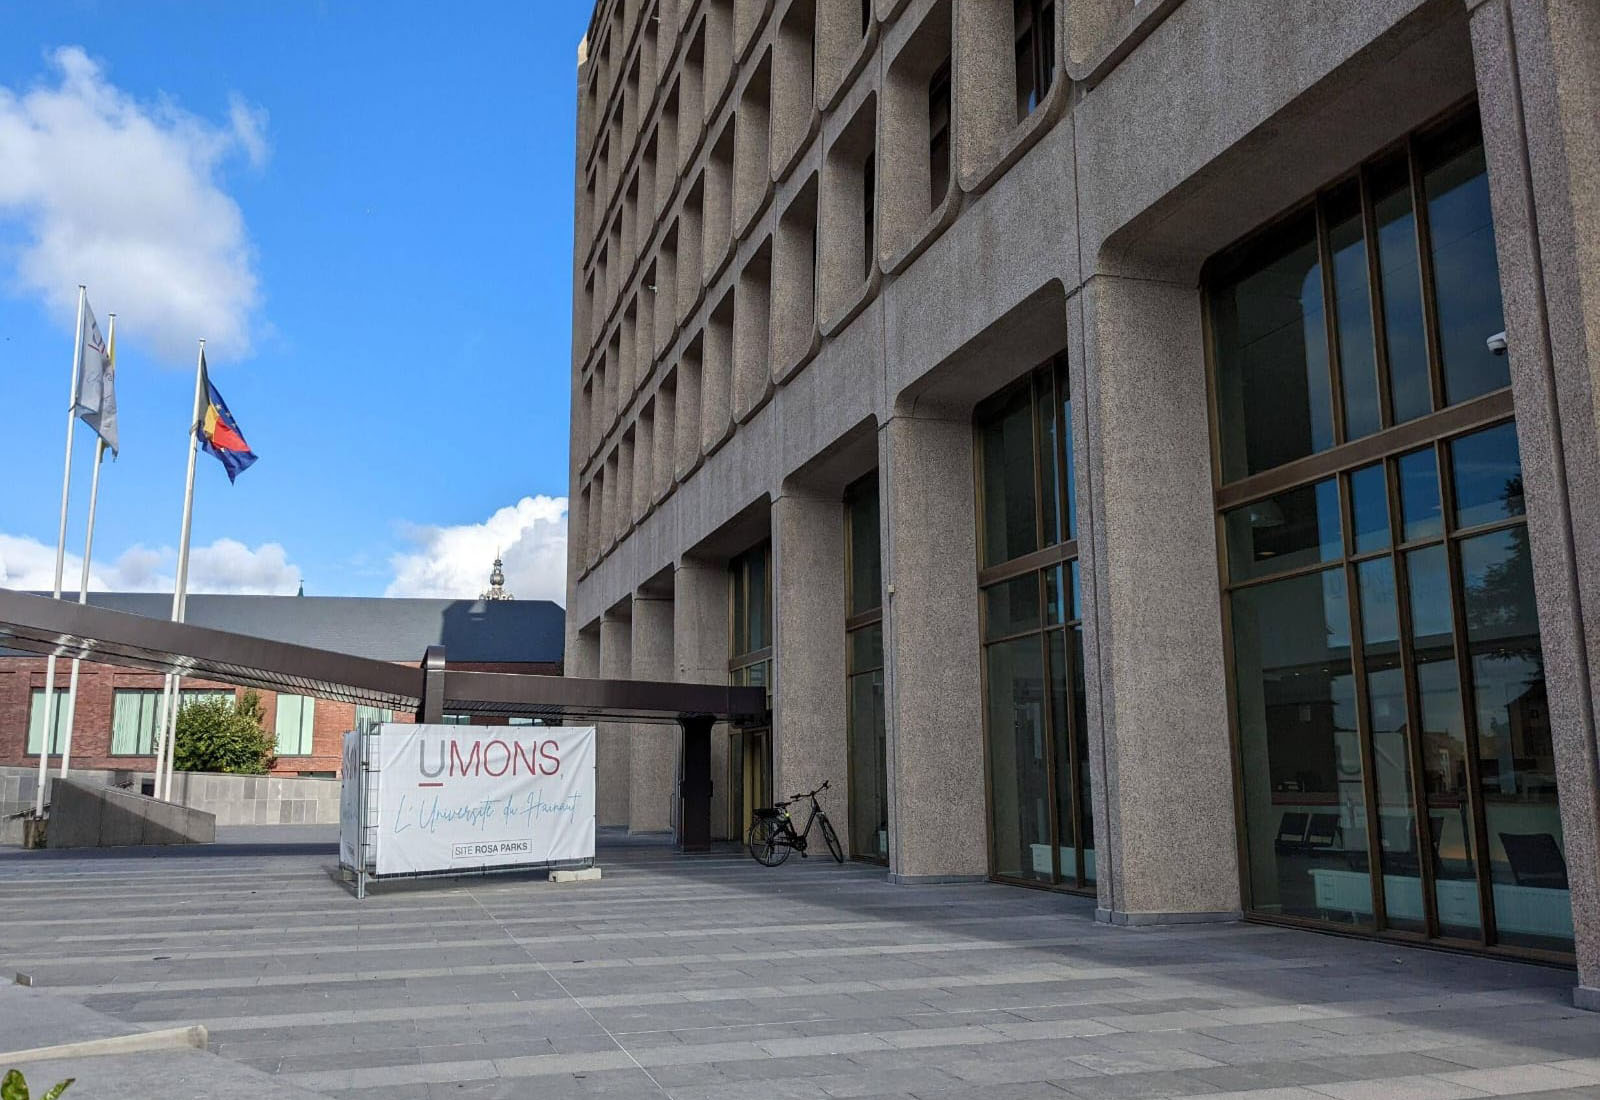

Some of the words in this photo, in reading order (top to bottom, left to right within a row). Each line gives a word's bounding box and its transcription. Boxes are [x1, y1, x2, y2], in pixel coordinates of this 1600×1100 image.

[419, 739, 561, 778] UMONS
[455, 846, 473, 856] SITE
[474, 844, 499, 855] ROSA
[500, 841, 529, 853] PARKS
